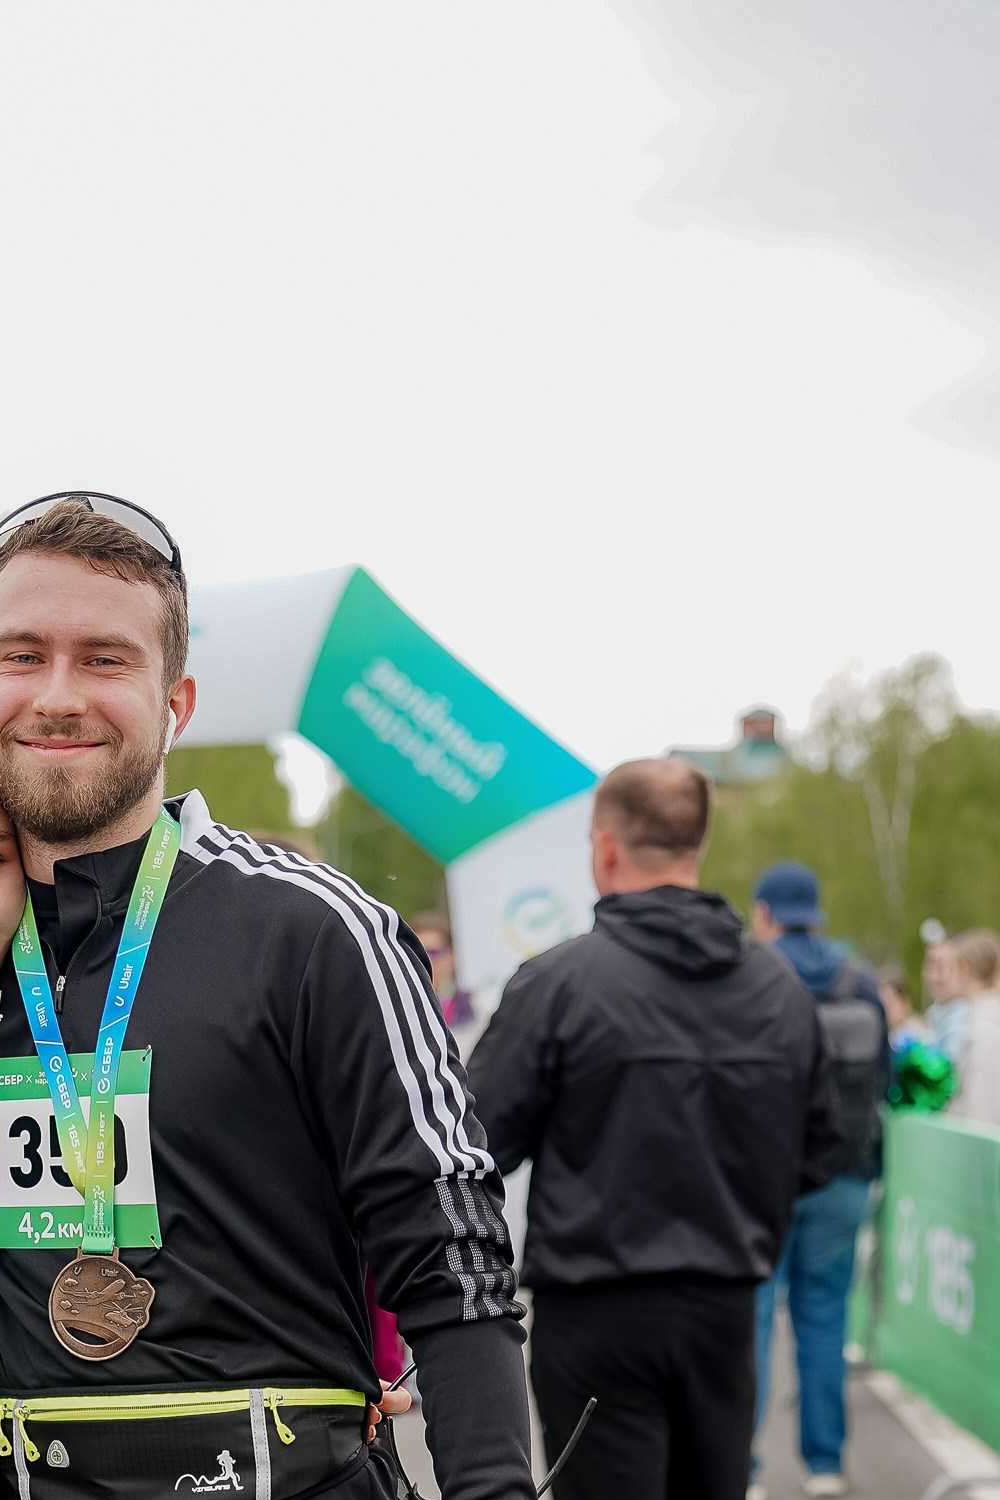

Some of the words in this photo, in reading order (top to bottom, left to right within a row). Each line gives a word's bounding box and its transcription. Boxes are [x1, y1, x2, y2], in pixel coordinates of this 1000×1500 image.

[118, 964, 134, 990] Utair
[35, 1001, 48, 1028] Utair
[101, 1037, 114, 1074] СБЕР
[55, 1074, 71, 1109] СБЕР
[68, 1124, 80, 1148] 185
[96, 1141, 105, 1166] 185
